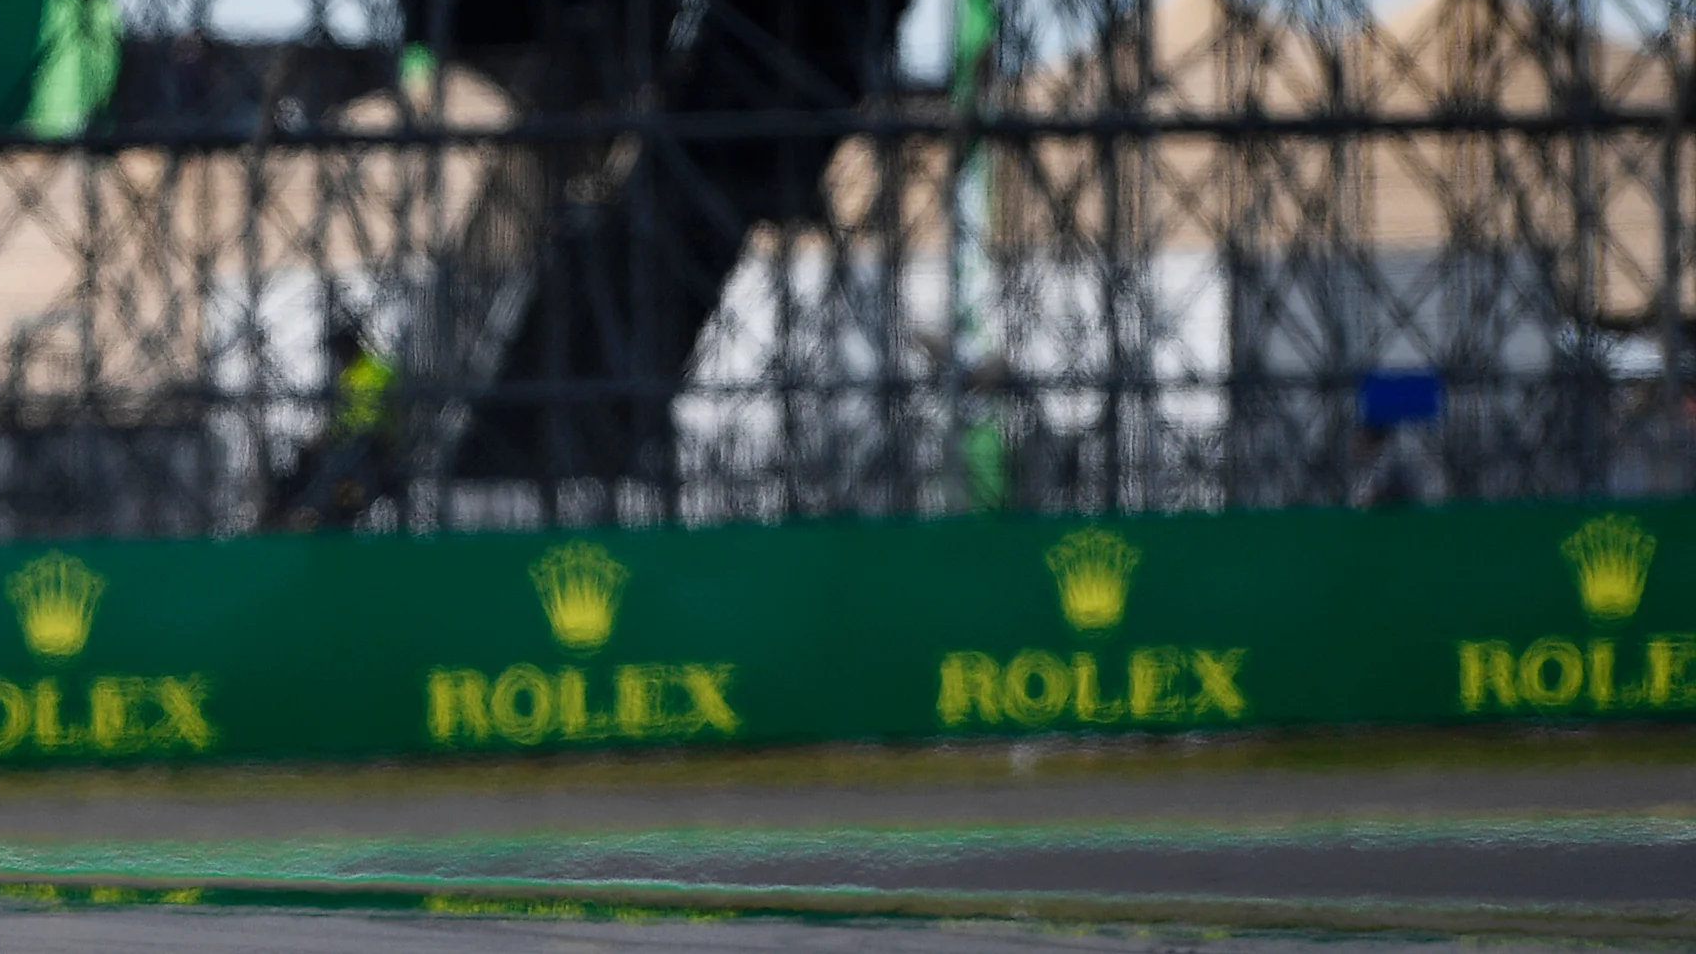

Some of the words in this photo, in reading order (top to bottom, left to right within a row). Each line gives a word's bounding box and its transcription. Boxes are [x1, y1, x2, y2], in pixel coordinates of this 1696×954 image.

[426, 663, 741, 745] ROLEX
[936, 646, 1249, 726] ROLEX
[1456, 634, 1696, 713] ROLE
